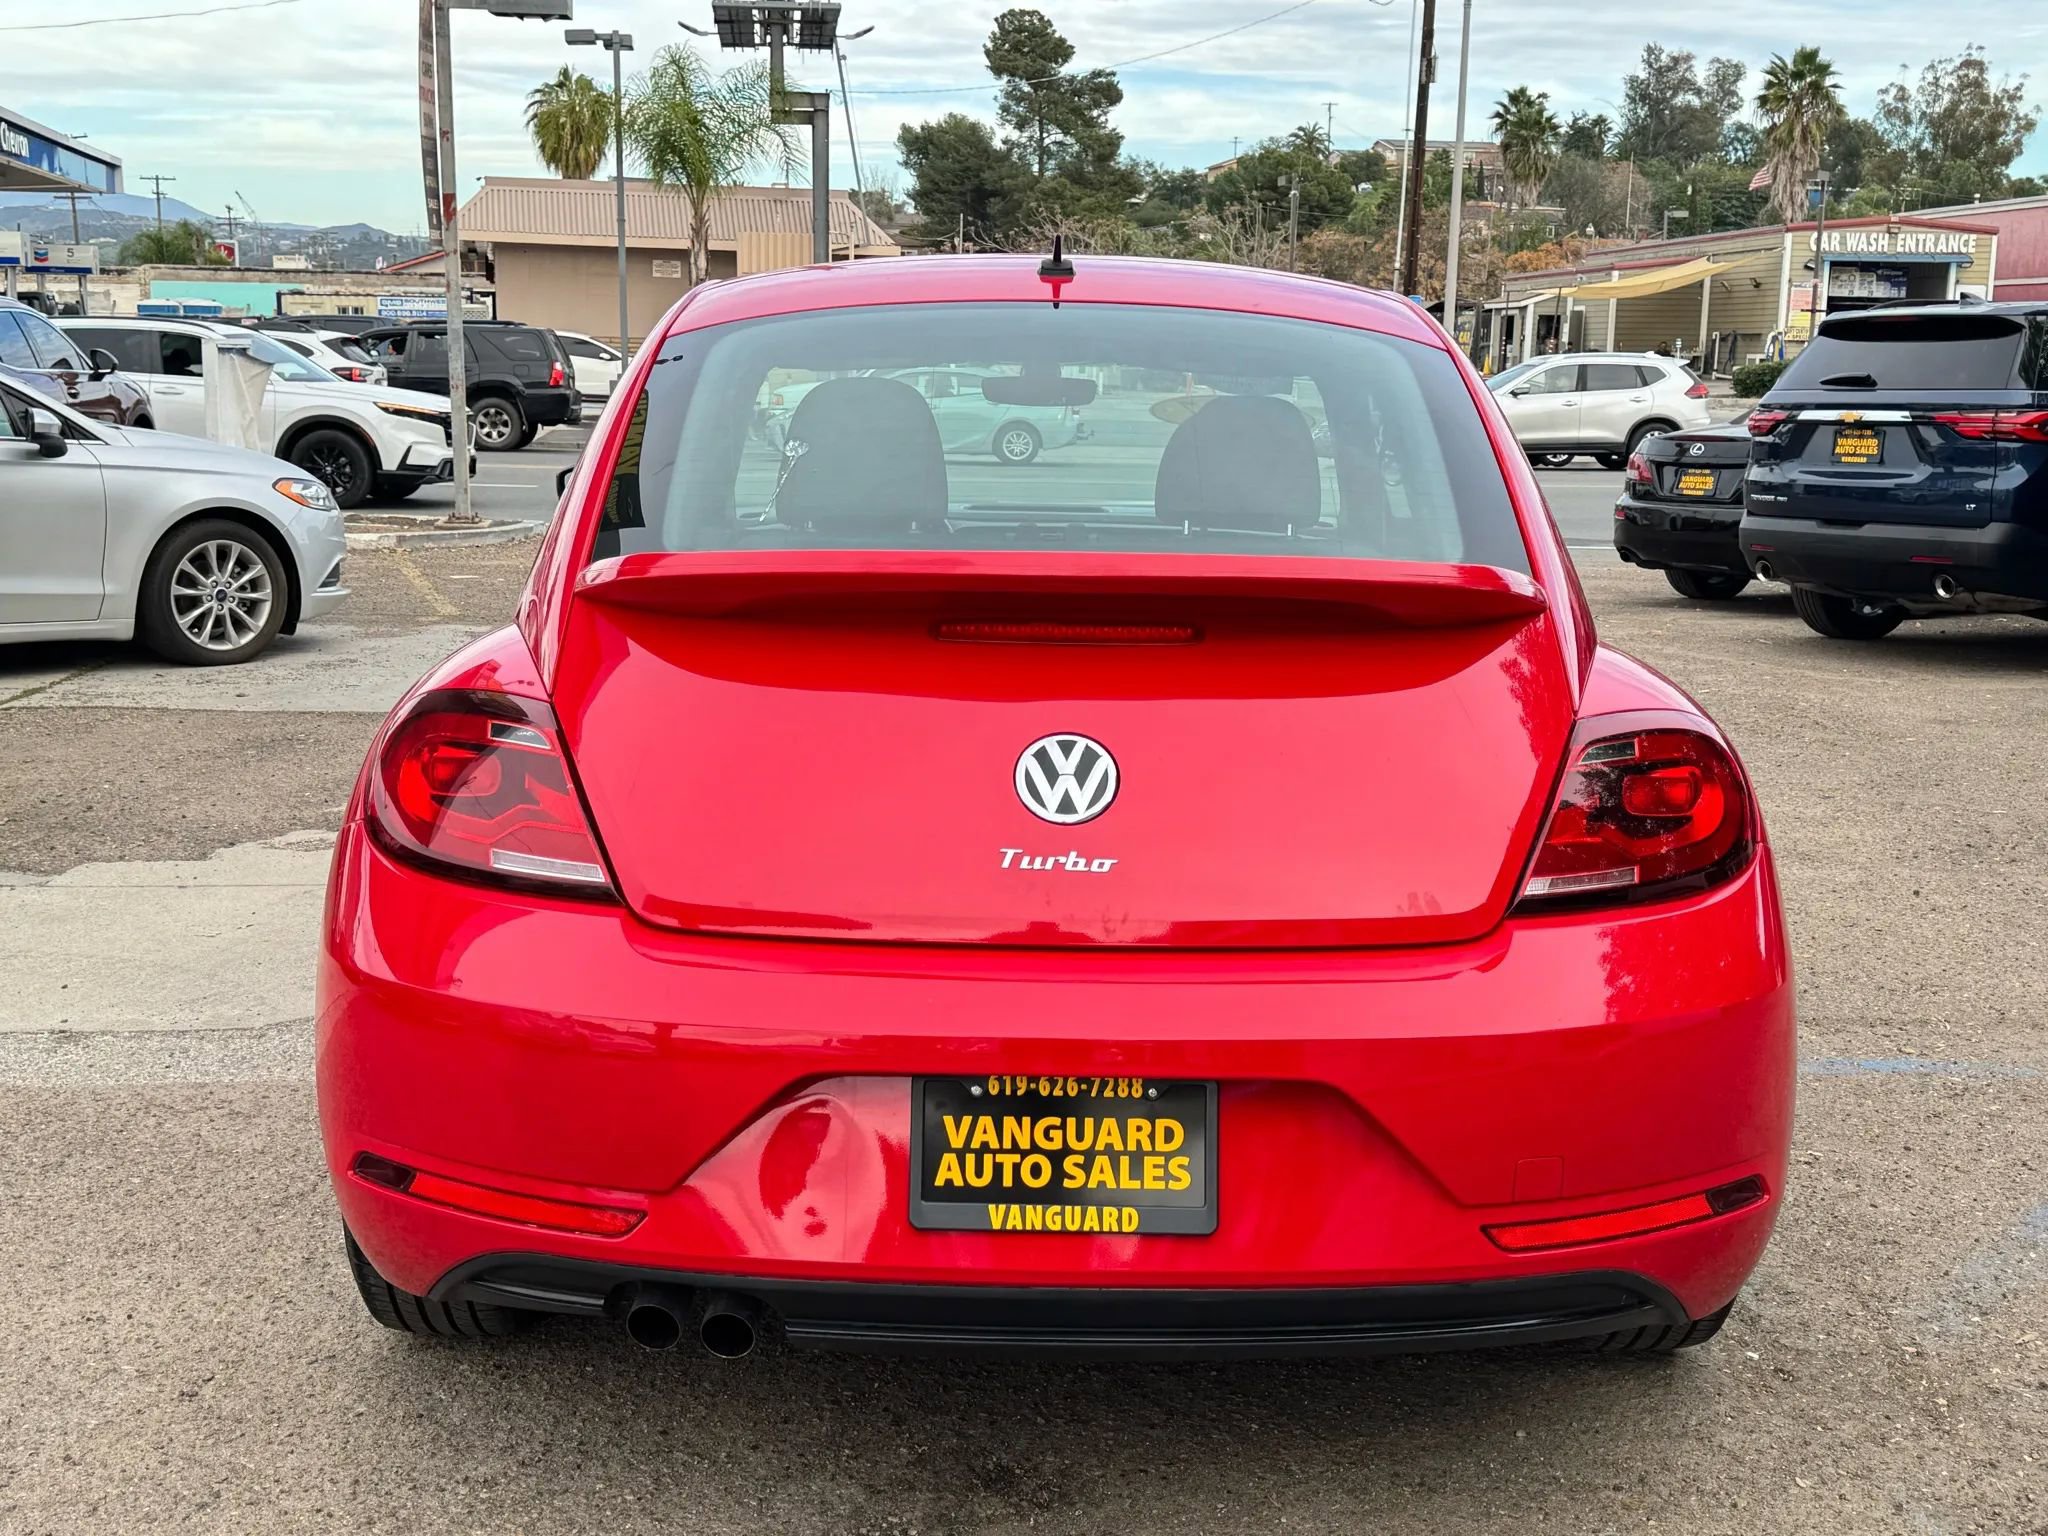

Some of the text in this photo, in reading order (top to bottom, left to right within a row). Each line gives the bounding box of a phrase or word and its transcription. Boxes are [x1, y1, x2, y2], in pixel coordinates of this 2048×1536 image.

[1, 121, 30, 158] Chevron
[1809, 232, 1977, 254] CAR WASH ENTRANCE
[1834, 445, 1879, 455] AUTO SALES
[1837, 438, 1879, 447] VANGUARD
[1682, 475, 1714, 483] VANGUARD
[1000, 848, 1119, 873] Turbo
[988, 1076, 1144, 1099] 619-626-7288
[943, 1115, 1185, 1152] VANGUARD
[934, 1153, 1192, 1191] AUTO SALES
[988, 1204, 1140, 1233] VANGUARD
